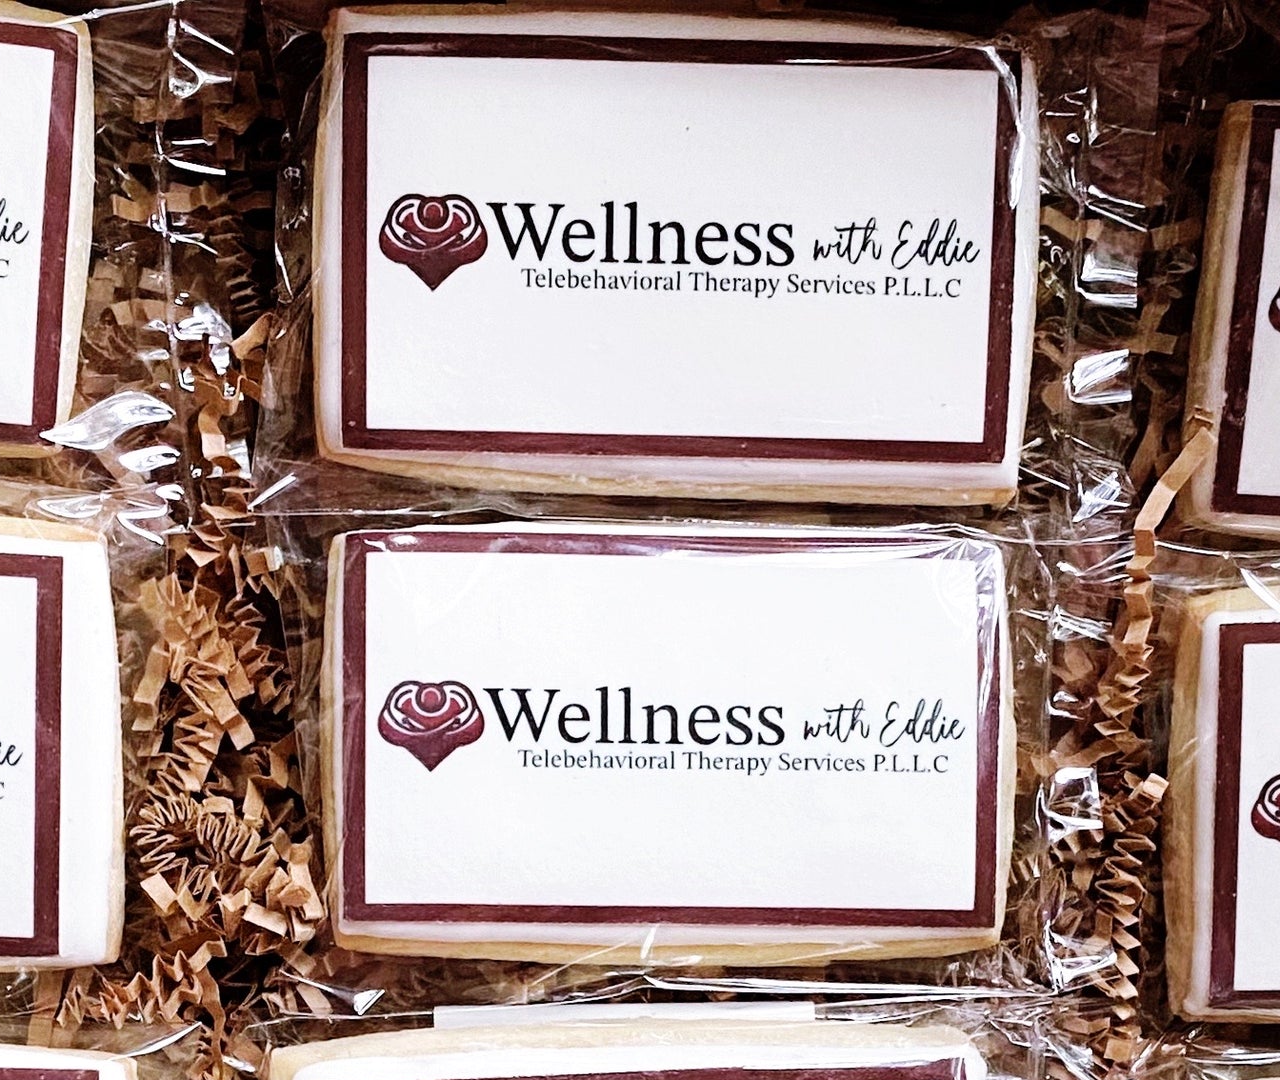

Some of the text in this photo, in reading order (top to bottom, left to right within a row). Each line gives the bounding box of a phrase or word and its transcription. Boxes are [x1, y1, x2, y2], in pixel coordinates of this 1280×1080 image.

[486, 201, 980, 270] Wellness with Eddie
[521, 268, 961, 298] Telebehavioral Therapy Services P.L.L.C
[483, 686, 965, 747] Wellness with Eddie
[518, 749, 948, 776] Telebehavioral Therapy Services P.L.L.C
